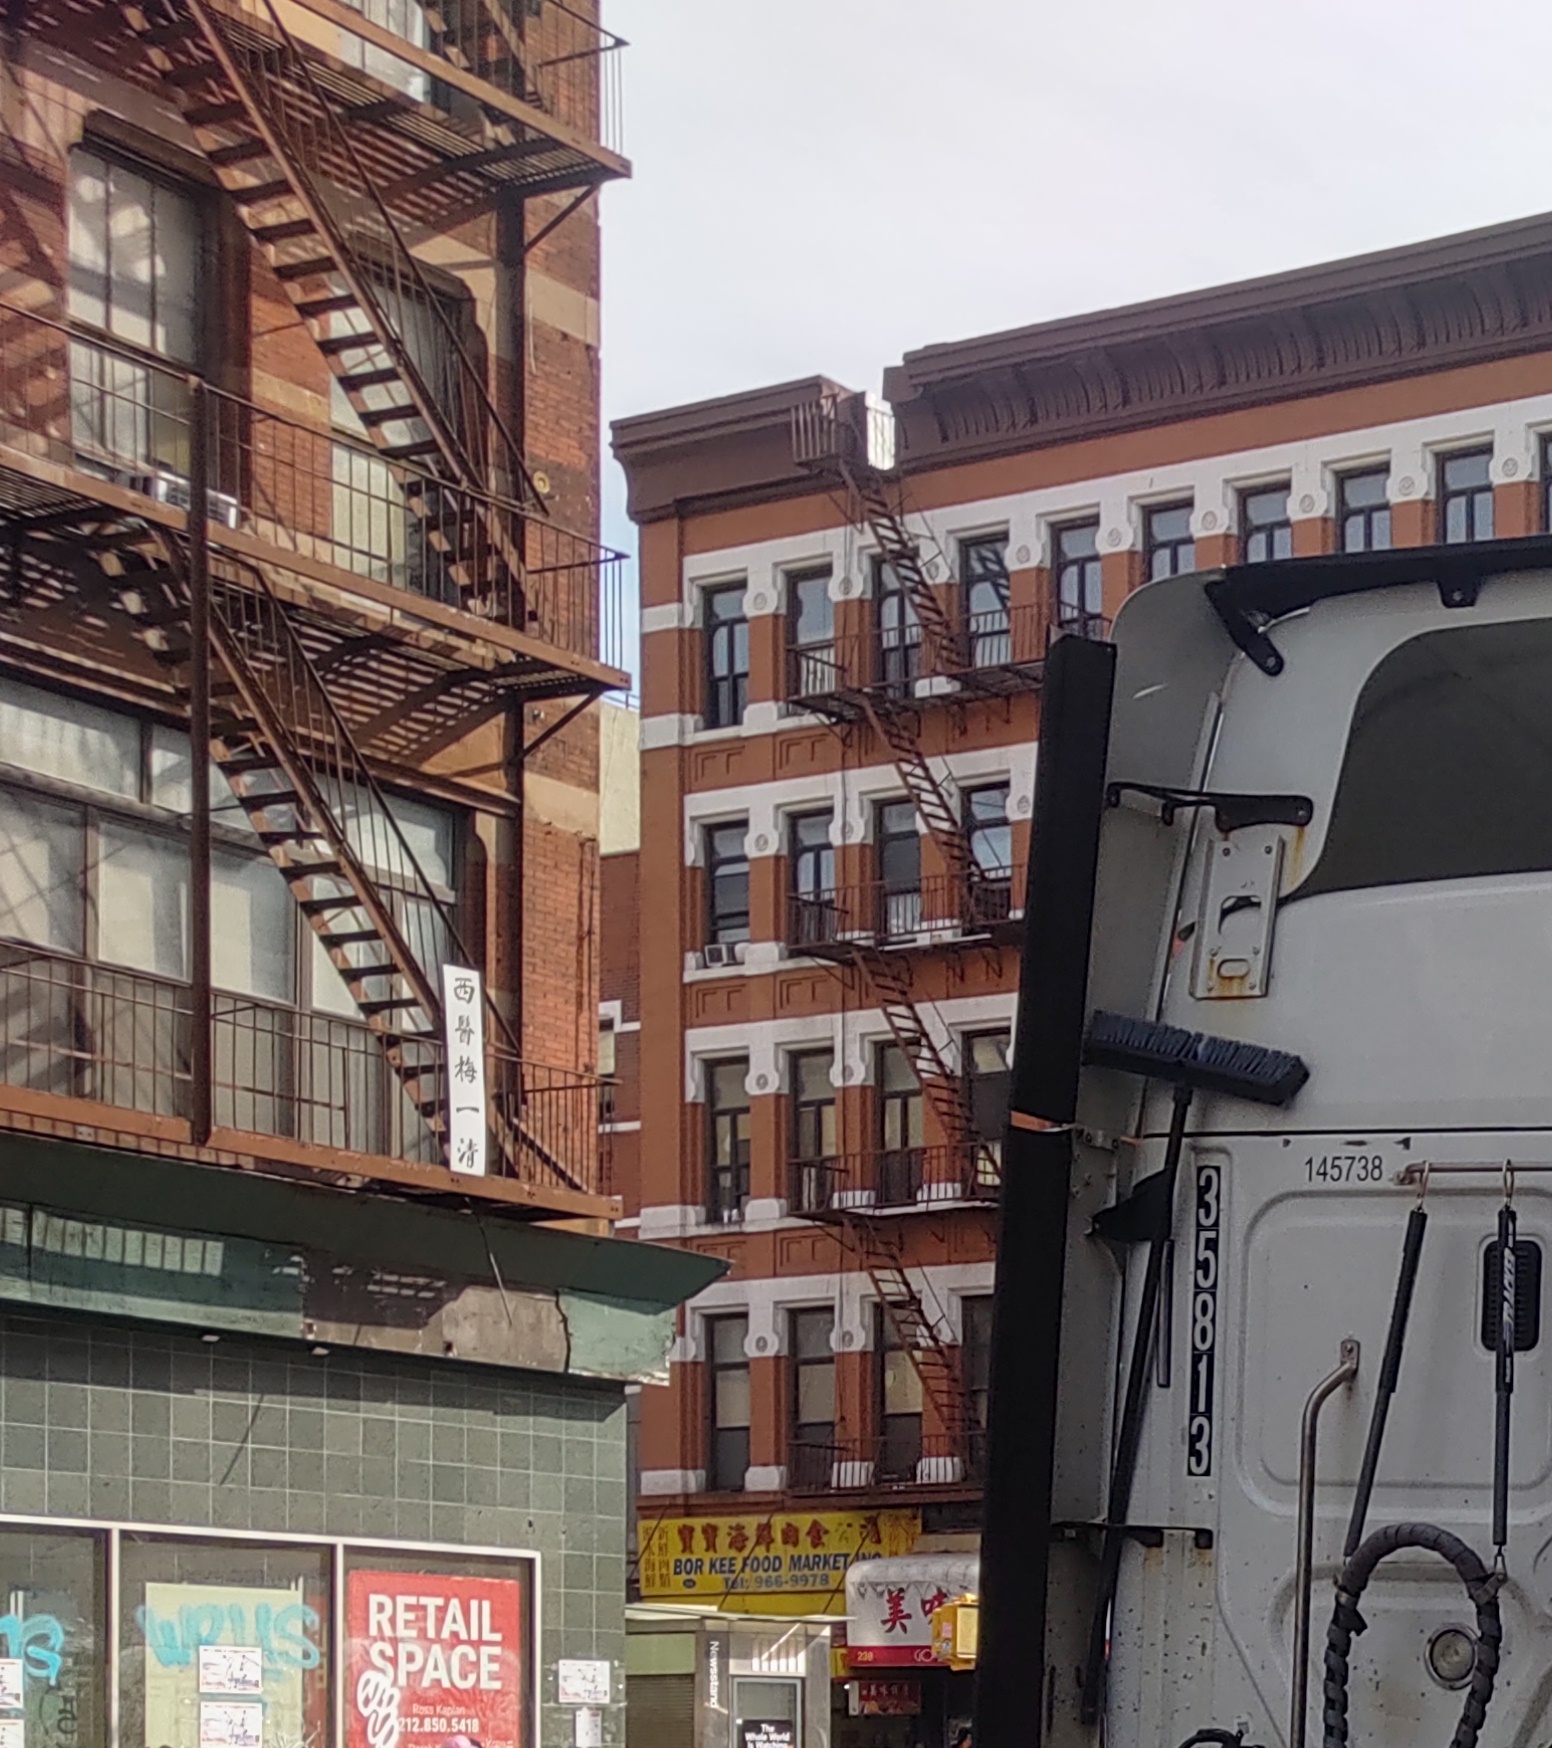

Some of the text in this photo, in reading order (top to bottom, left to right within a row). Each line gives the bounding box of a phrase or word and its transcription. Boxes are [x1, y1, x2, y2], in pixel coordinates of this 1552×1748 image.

[1304, 1155, 1383, 1182] 145738
[1189, 1167, 1219, 1475] 35813
[674, 1558, 703, 1575] BOR
[709, 1557, 736, 1574] KEE
[741, 1556, 782, 1574] FOOD
[789, 1554, 850, 1572] MARKET
[755, 1575, 829, 1589] 966-9978
[369, 1594, 502, 1641] RETAIL
[369, 1641, 501, 1690] SPACE
[709, 1640, 719, 1708] Newsstand
[399, 1717, 479, 1734] 212.850.5418
[745, 1732, 790, 1741] Whole World
[761, 1723, 775, 1732] The
